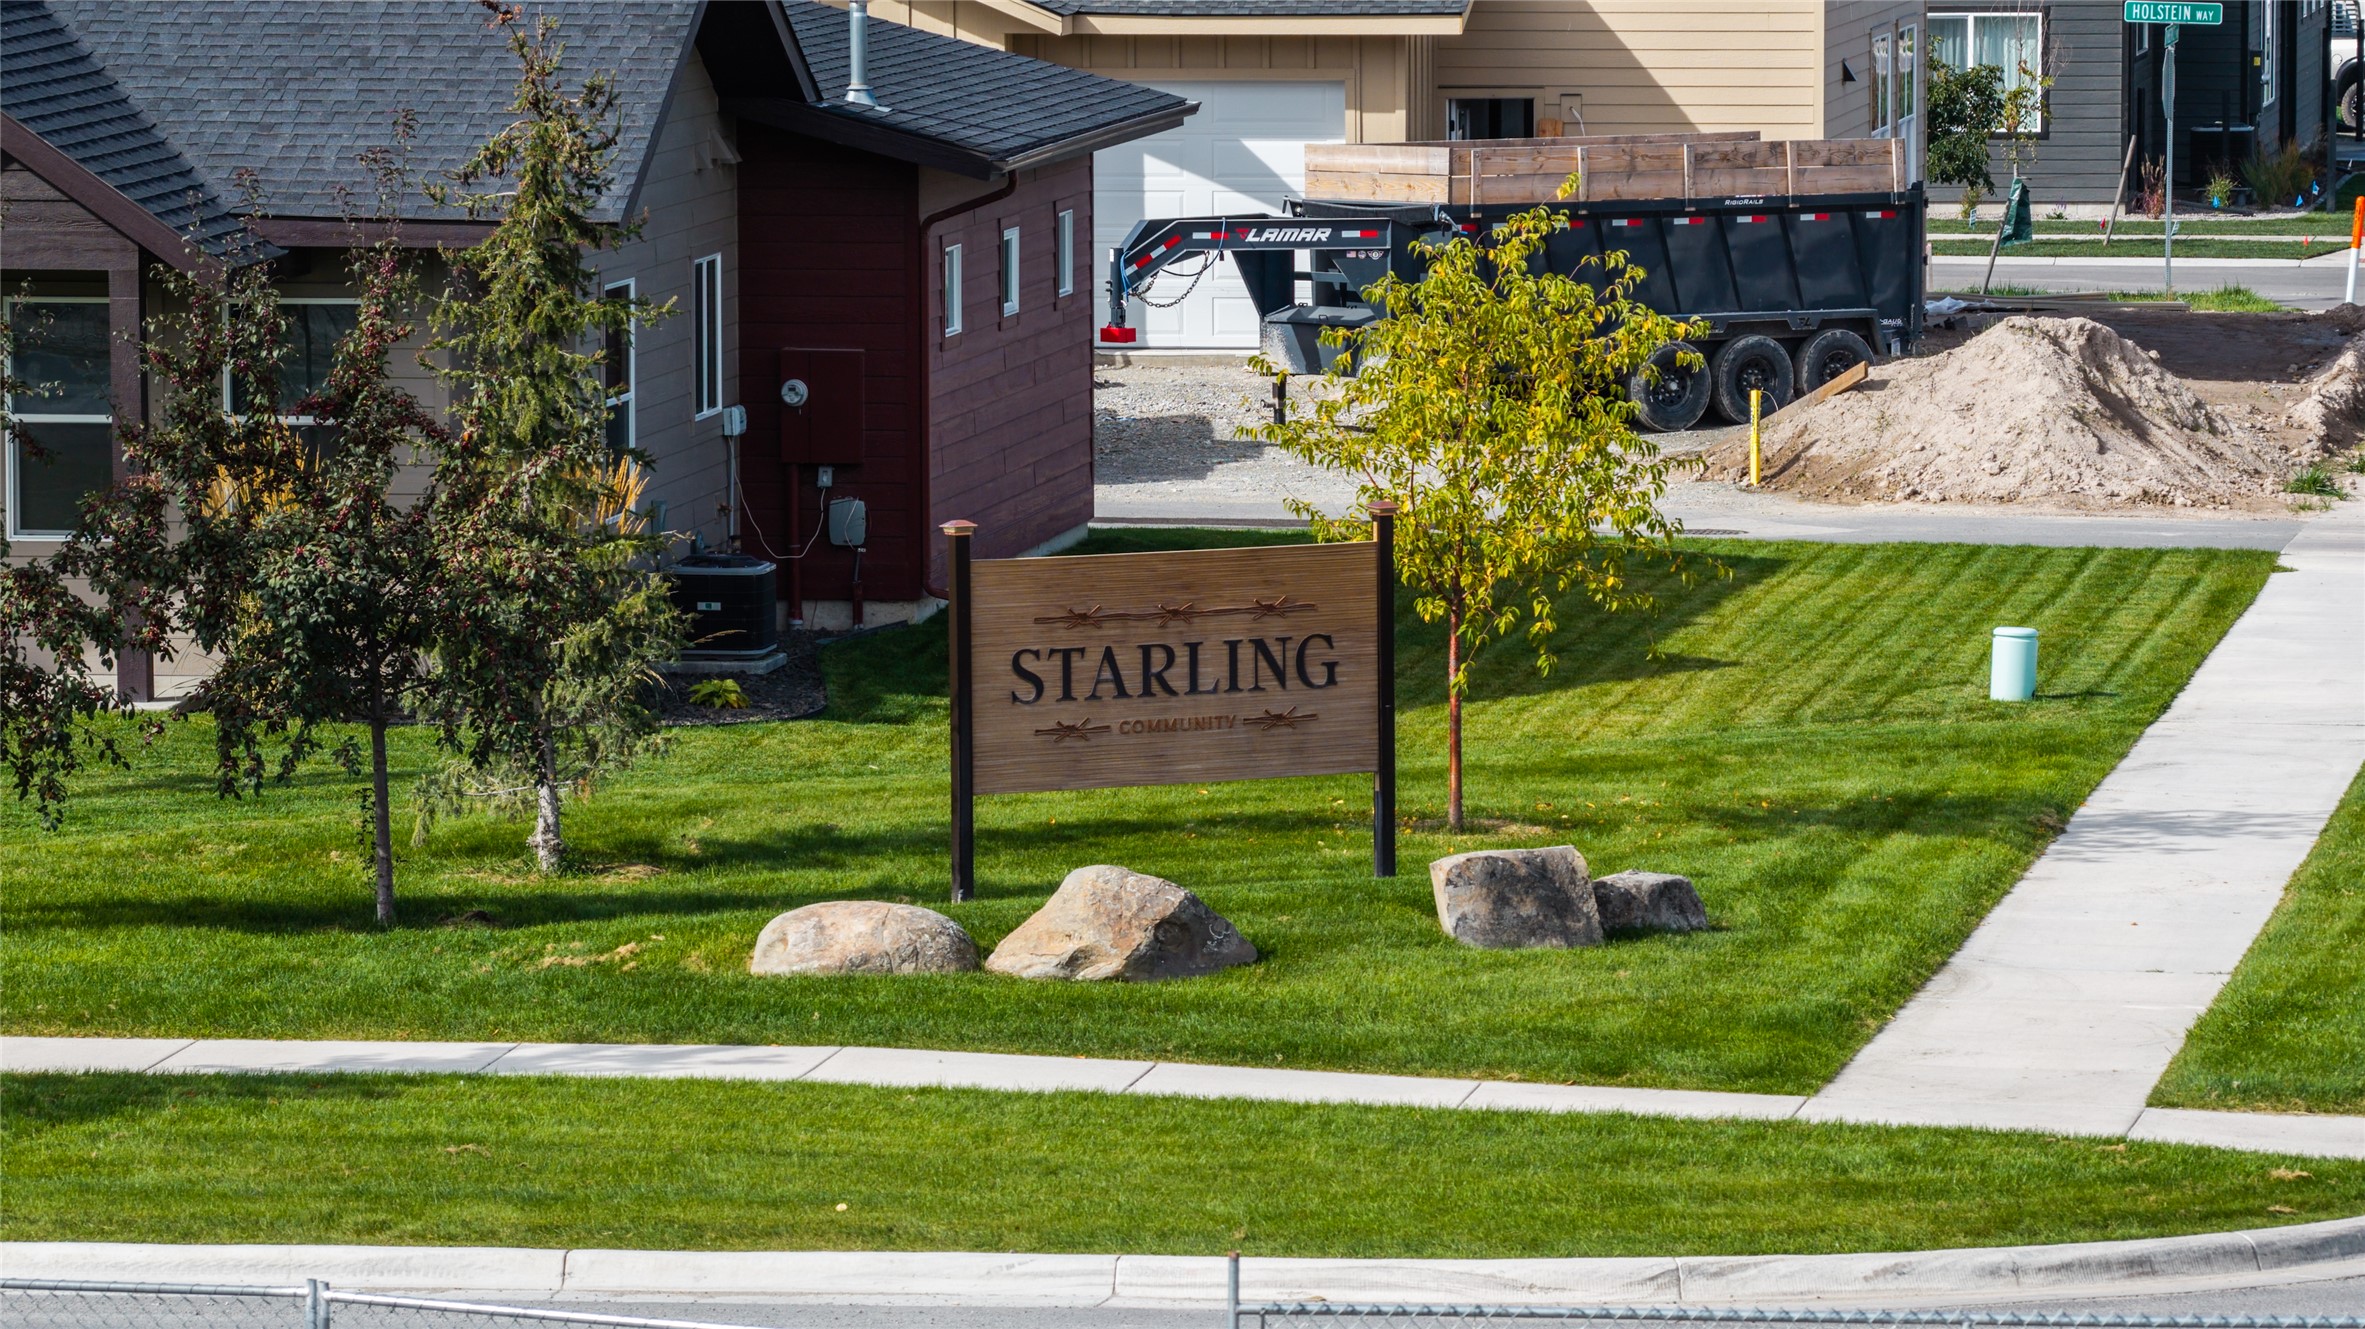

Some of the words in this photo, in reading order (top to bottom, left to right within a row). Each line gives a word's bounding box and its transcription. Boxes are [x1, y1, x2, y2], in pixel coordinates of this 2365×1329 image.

[2132, 4, 2191, 20] HOLSTEIN
[2196, 10, 2214, 21] WAY
[1245, 227, 1332, 242] LAMAR
[1011, 633, 1340, 705] STARLING
[1118, 714, 1237, 735] COMMUNITY
